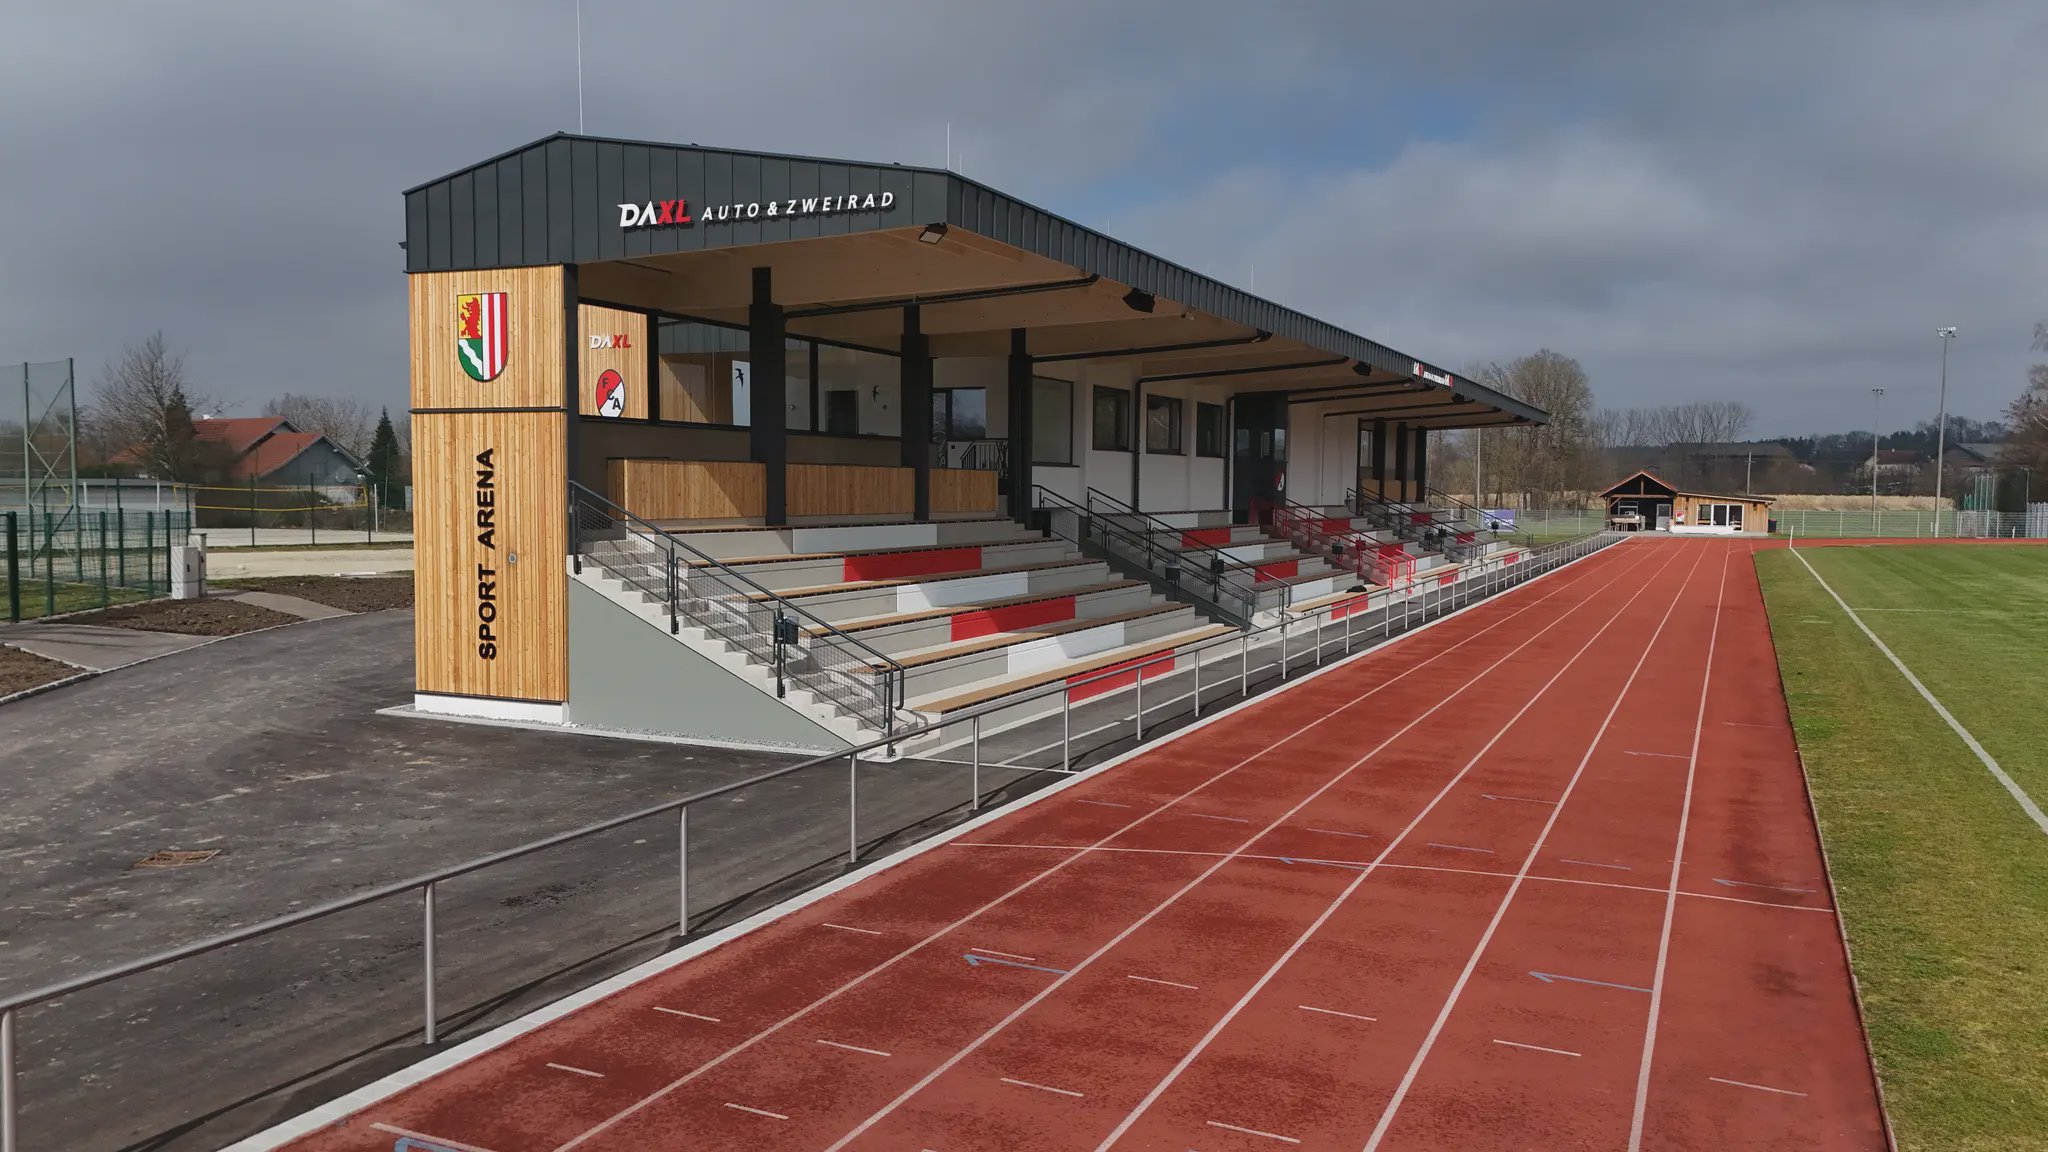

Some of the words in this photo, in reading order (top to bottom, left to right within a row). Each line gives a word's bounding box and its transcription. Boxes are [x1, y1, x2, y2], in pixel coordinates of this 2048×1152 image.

[617, 199, 692, 227] DAXL
[701, 203, 760, 221] AUTO
[767, 201, 778, 217] &
[786, 192, 894, 215] ZWEIRAD
[590, 334, 632, 350] DAXL
[476, 448, 495, 550] ARENA
[478, 563, 497, 661] SPORT
